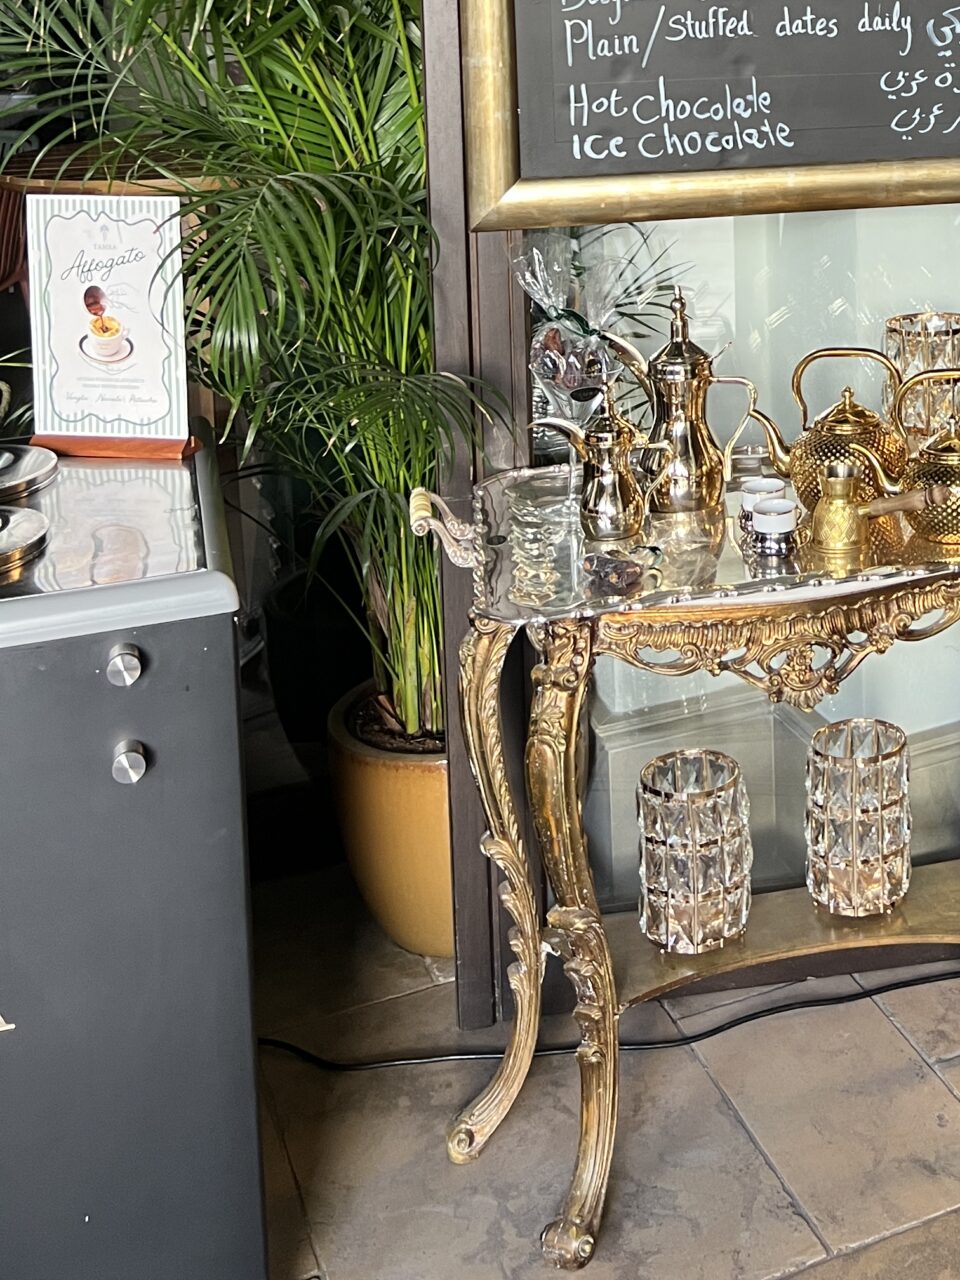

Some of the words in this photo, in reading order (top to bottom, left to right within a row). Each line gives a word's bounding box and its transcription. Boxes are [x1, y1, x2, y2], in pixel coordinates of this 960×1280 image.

[776, 6, 839, 38] dates
[857, 0, 912, 57] daily
[569, 83, 629, 127] Hot
[60, 247, 147, 284] Affogato
